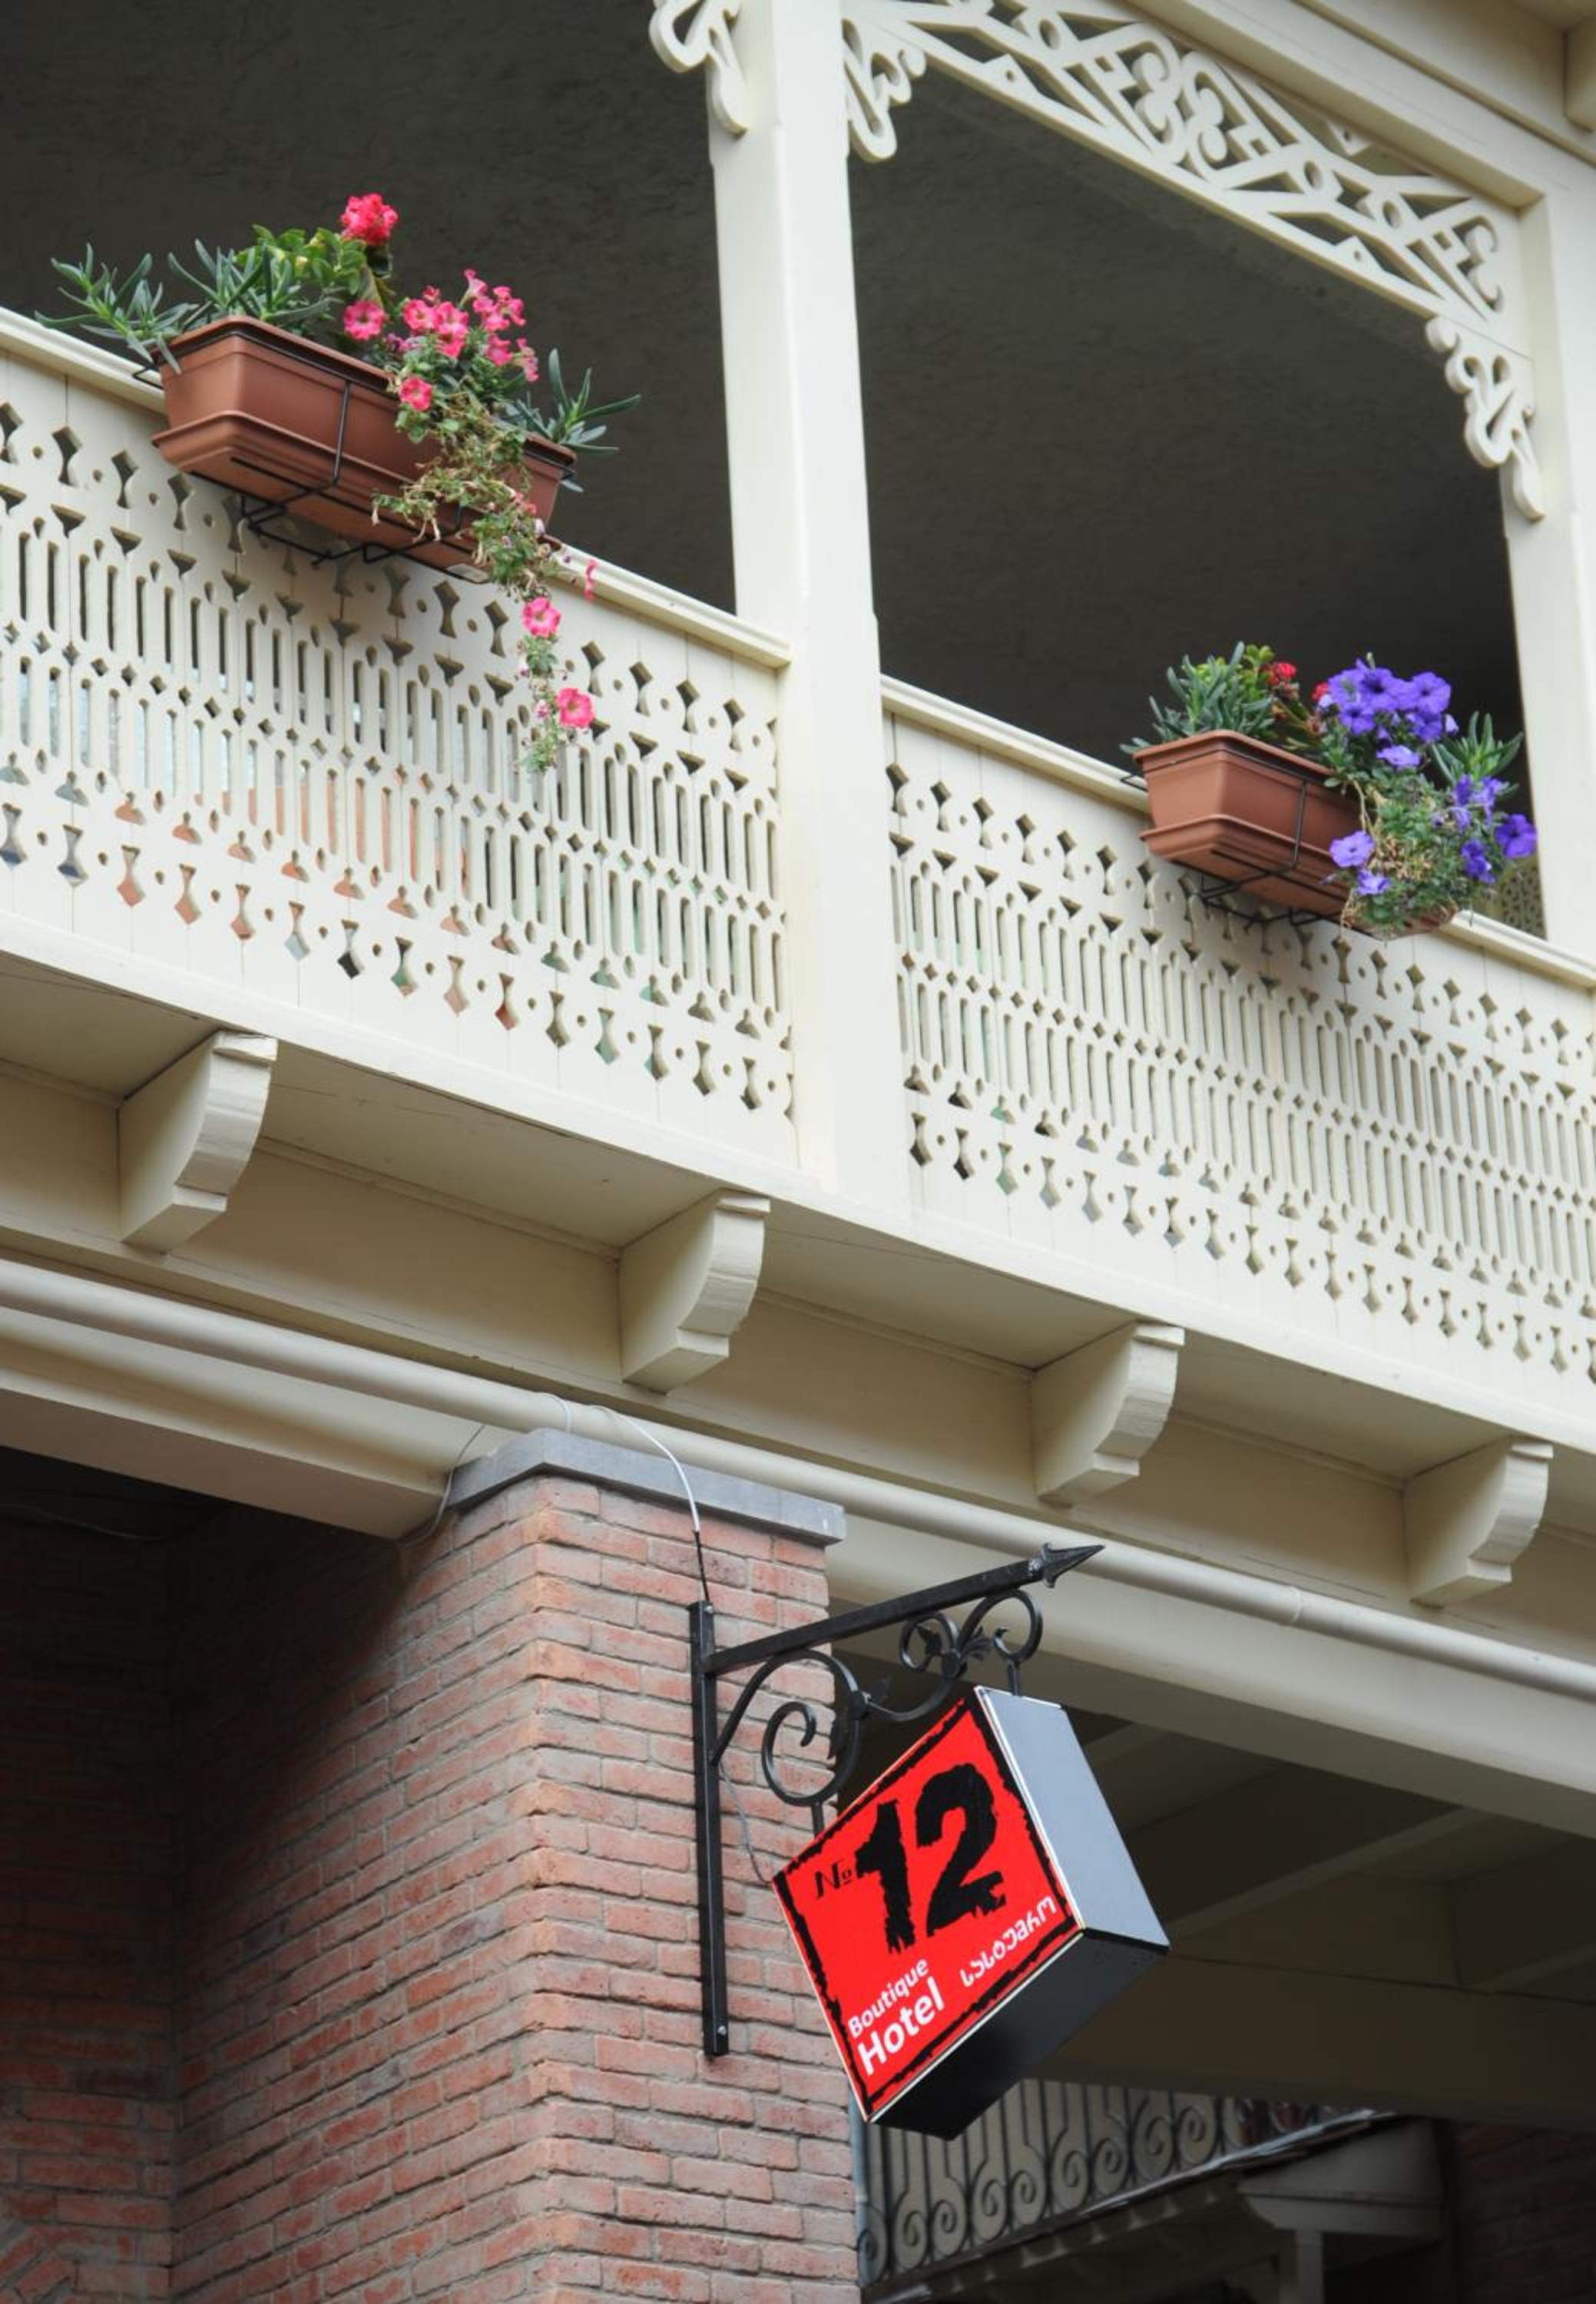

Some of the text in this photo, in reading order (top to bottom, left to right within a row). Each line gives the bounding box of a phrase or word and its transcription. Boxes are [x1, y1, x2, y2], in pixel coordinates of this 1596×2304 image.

[854, 1762, 1007, 1953] 12
[959, 1895, 1058, 1988] სასტუმრო
[847, 1958, 929, 2039] Boutique
[856, 1975, 945, 2077] Hotel
